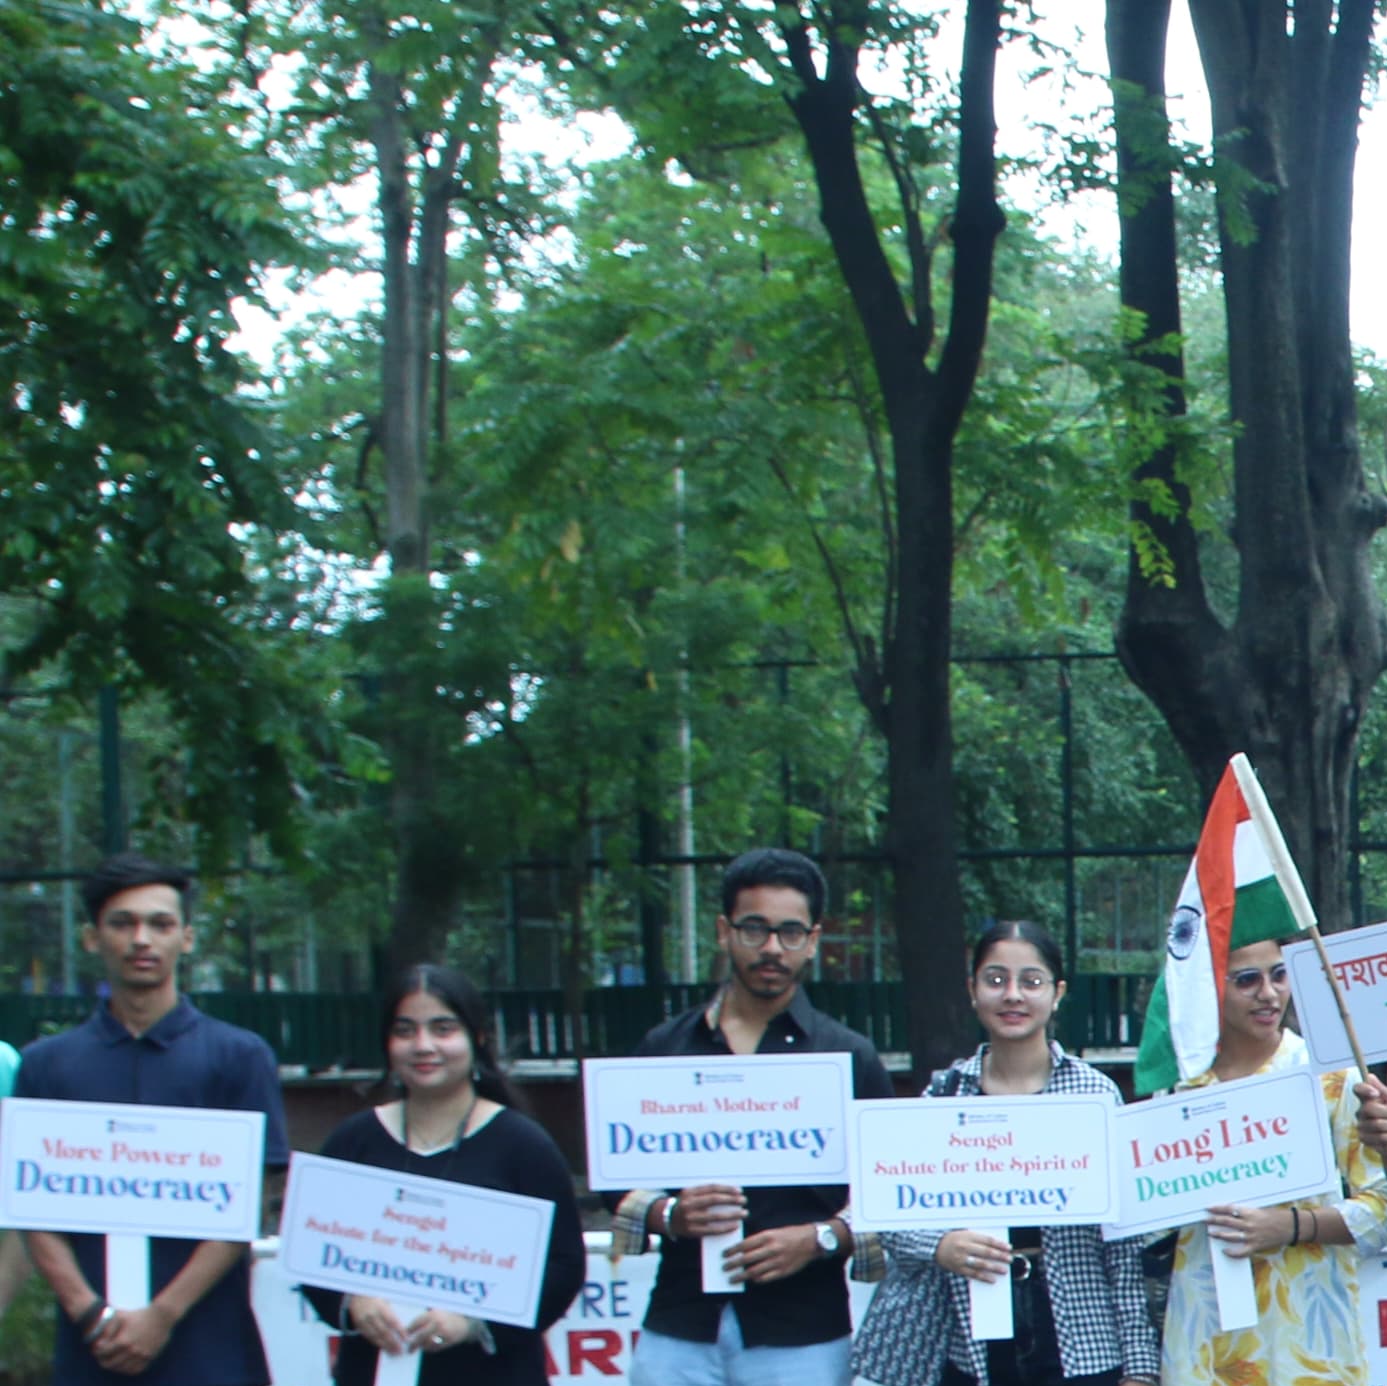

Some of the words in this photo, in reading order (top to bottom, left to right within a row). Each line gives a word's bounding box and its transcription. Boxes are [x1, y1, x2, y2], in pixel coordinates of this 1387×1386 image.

[713, 1097, 778, 1113] Mother
[783, 1096, 801, 1111] of
[43, 1137, 103, 1161] More
[110, 1141, 192, 1167] Power
[199, 1151, 222, 1167] to
[607, 1122, 834, 1158] Democracy
[948, 1131, 1013, 1150] Sengol
[1130, 1128, 1214, 1169] Long
[1217, 1115, 1289, 1148] Live
[874, 1160, 936, 1175] Salute
[943, 1158, 969, 1174] for
[974, 1157, 1004, 1173] the
[1010, 1154, 1065, 1176] Spirit
[1071, 1154, 1090, 1169] of
[1135, 1151, 1292, 1201] Democracy
[16, 1160, 240, 1211] Democracy
[896, 1183, 1075, 1212] Democracy
[384, 1207, 446, 1231] Sengol
[305, 1216, 366, 1240] Salute
[372, 1229, 398, 1246] for
[404, 1235, 432, 1253] the
[437, 1243, 493, 1265] Spirit
[497, 1255, 517, 1269] of
[320, 1243, 496, 1302] Democracy
